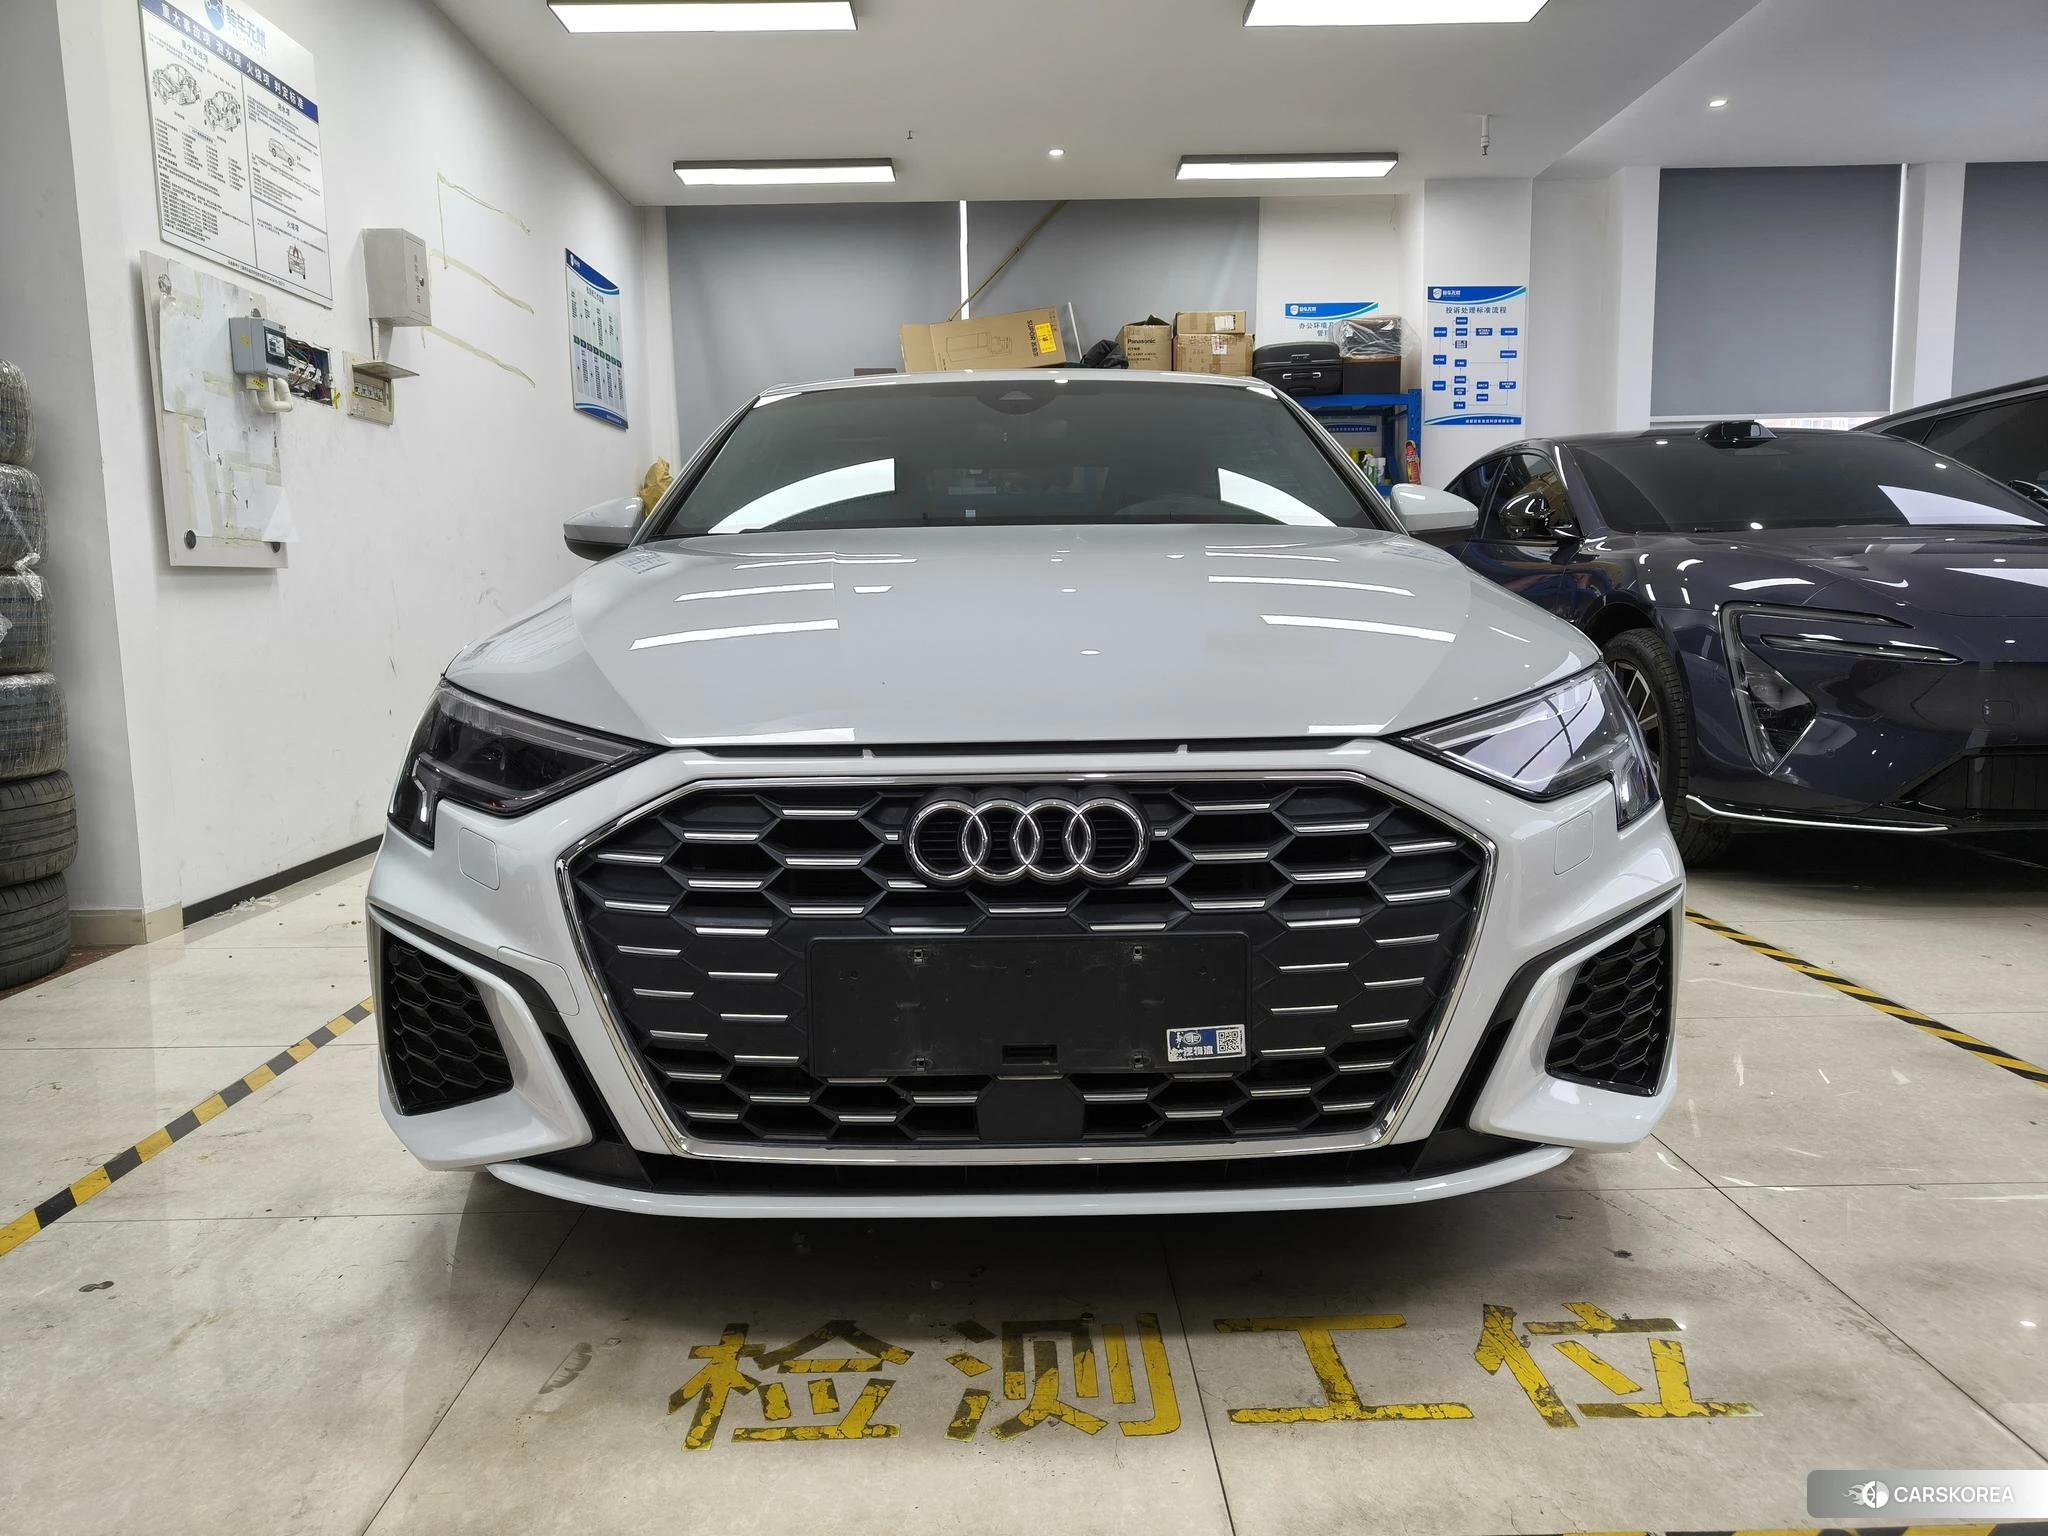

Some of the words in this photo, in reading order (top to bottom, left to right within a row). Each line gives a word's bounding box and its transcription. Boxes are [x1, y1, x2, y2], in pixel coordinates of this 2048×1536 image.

[161, 3, 211, 49] 重大事故项
[246, 60, 270, 88] 火烧项
[274, 77, 304, 110] 判定标准
[1027, 319, 1036, 341] SUPOR
[1445, 306, 1507, 314] 投诉处理标准流程
[667, 1302, 1764, 1451] 检测工位
